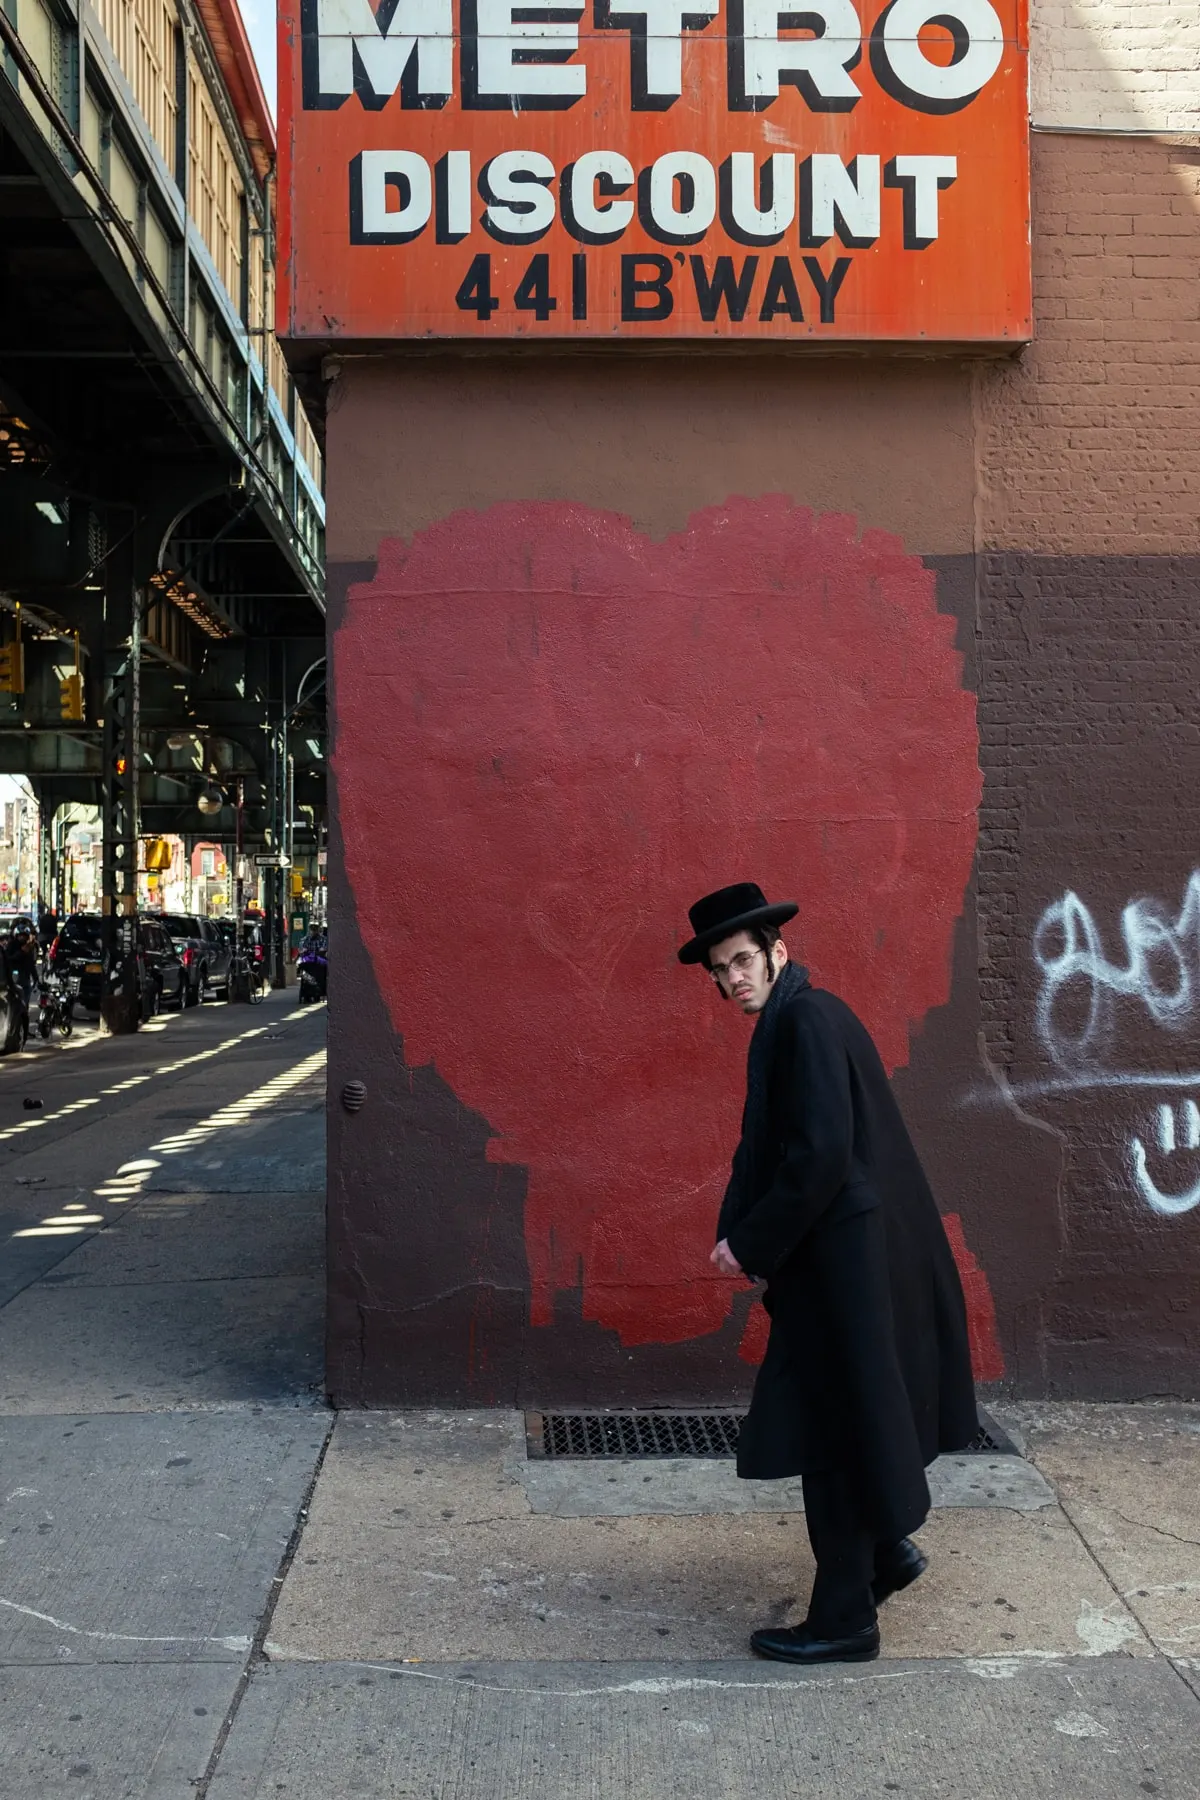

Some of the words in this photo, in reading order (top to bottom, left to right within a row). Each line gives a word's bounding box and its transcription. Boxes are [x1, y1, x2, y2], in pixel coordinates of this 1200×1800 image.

[302, 0, 1004, 115] METRO
[349, 150, 957, 249] DISCOUNT
[455, 253, 587, 321] 441
[621, 251, 852, 323] B'WAY
